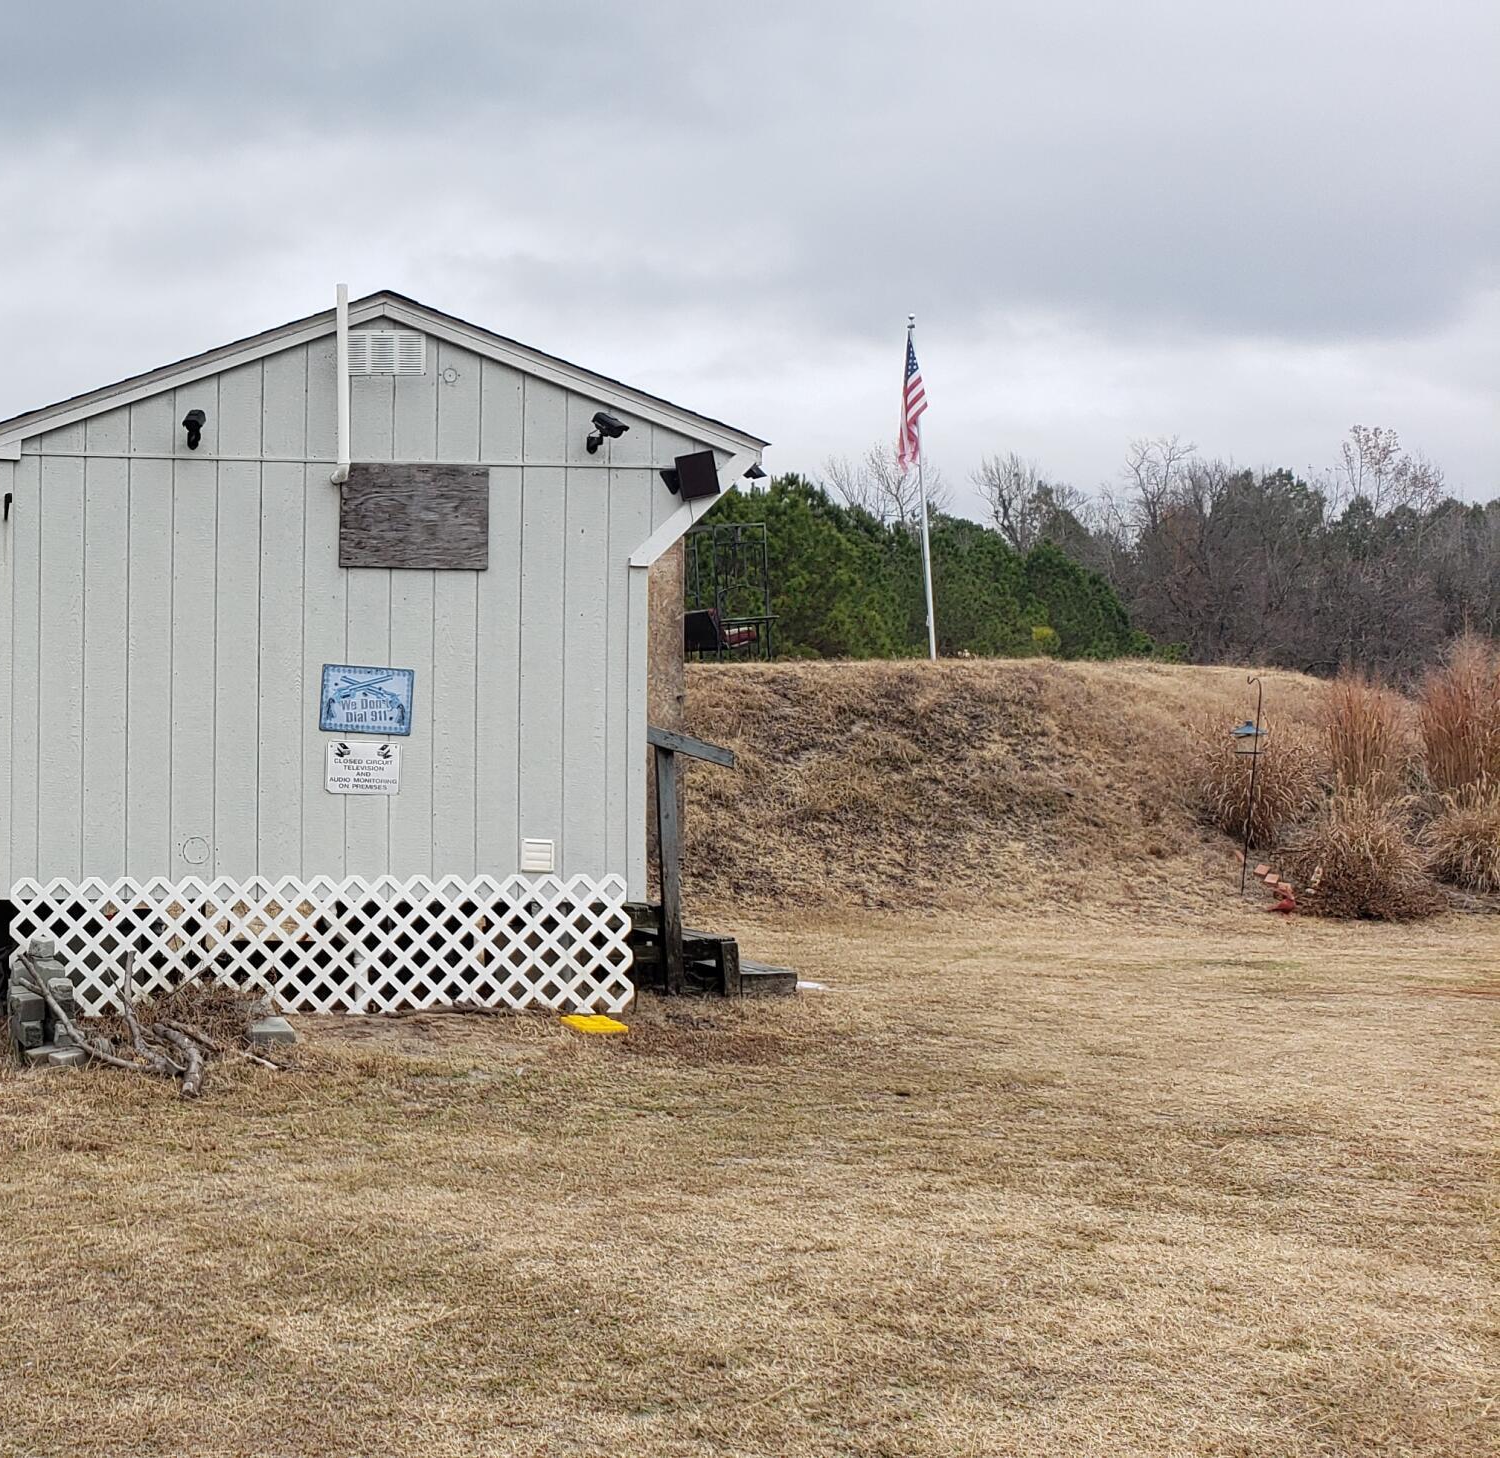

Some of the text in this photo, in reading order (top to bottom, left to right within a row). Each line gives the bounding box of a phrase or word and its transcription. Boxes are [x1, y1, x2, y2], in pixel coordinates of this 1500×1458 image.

[342, 700, 357, 710] We
[346, 710, 387, 722] Dial 911
